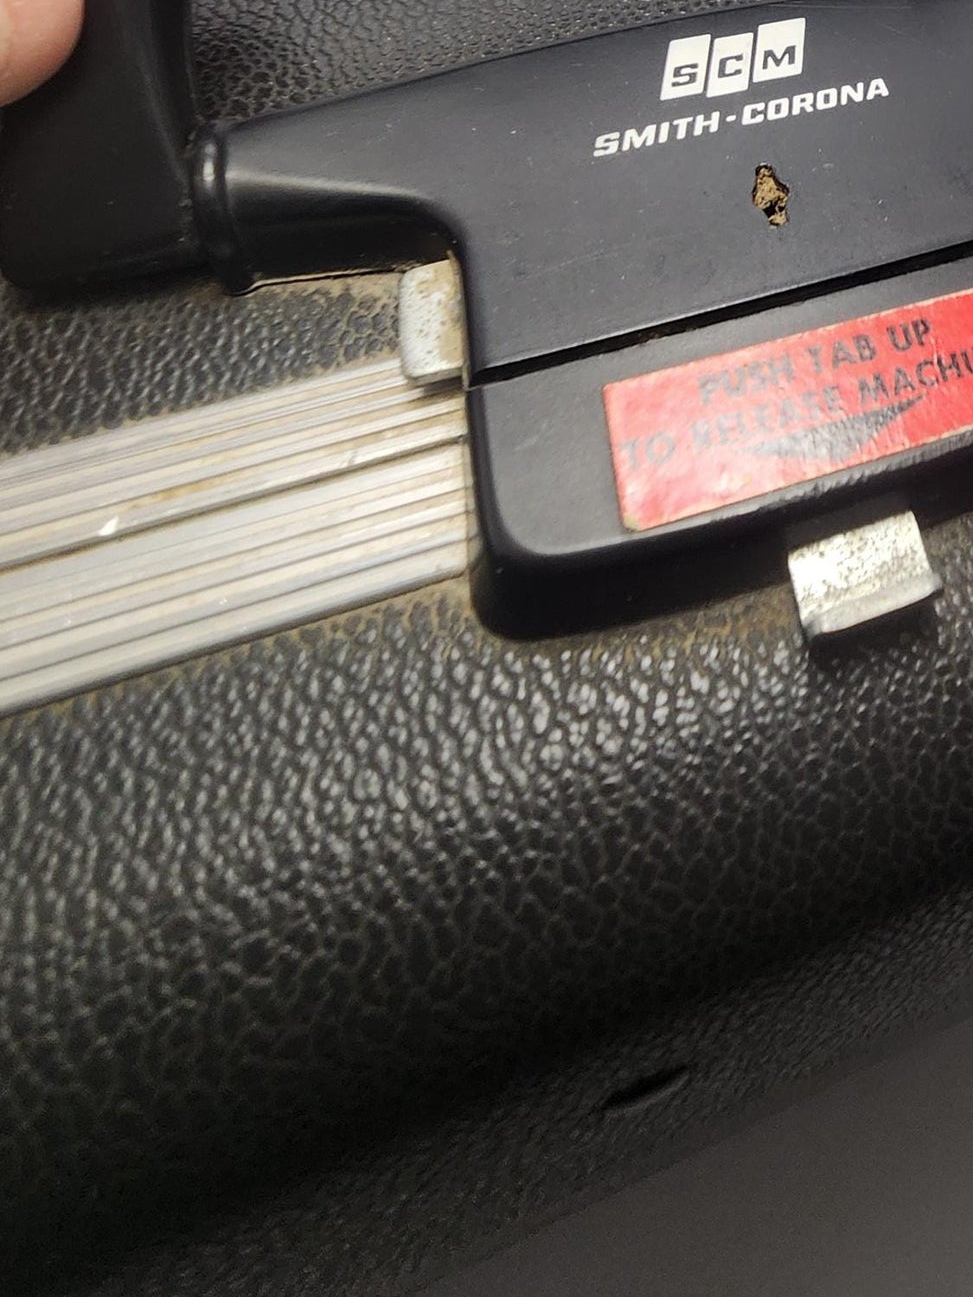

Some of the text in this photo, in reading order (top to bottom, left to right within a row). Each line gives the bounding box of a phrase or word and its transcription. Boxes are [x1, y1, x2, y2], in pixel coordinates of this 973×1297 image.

[592, 77, 890, 158] SMITH-CORONA
[698, 317, 932, 404] PUSH TAB UP
[620, 433, 675, 471] TO
